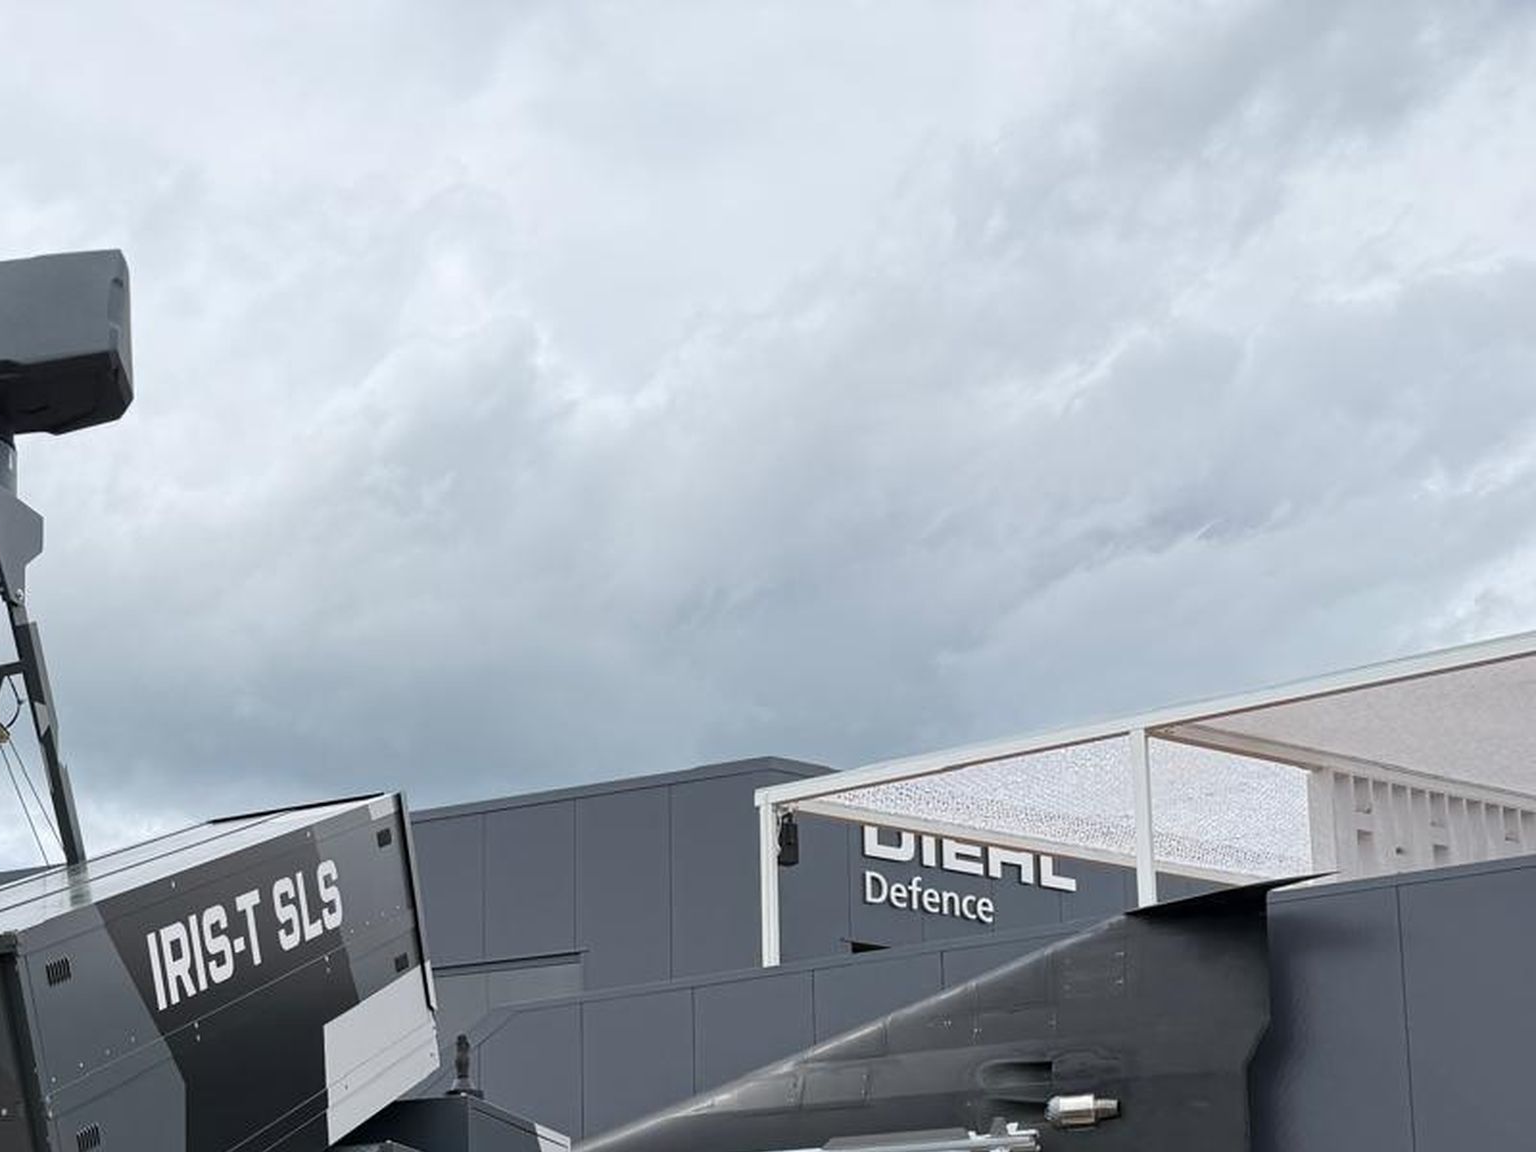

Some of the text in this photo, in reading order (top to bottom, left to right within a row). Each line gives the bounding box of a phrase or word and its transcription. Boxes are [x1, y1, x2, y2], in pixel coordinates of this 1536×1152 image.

[147, 860, 344, 1012] IRIS-T SLS
[865, 871, 995, 924] Defence
